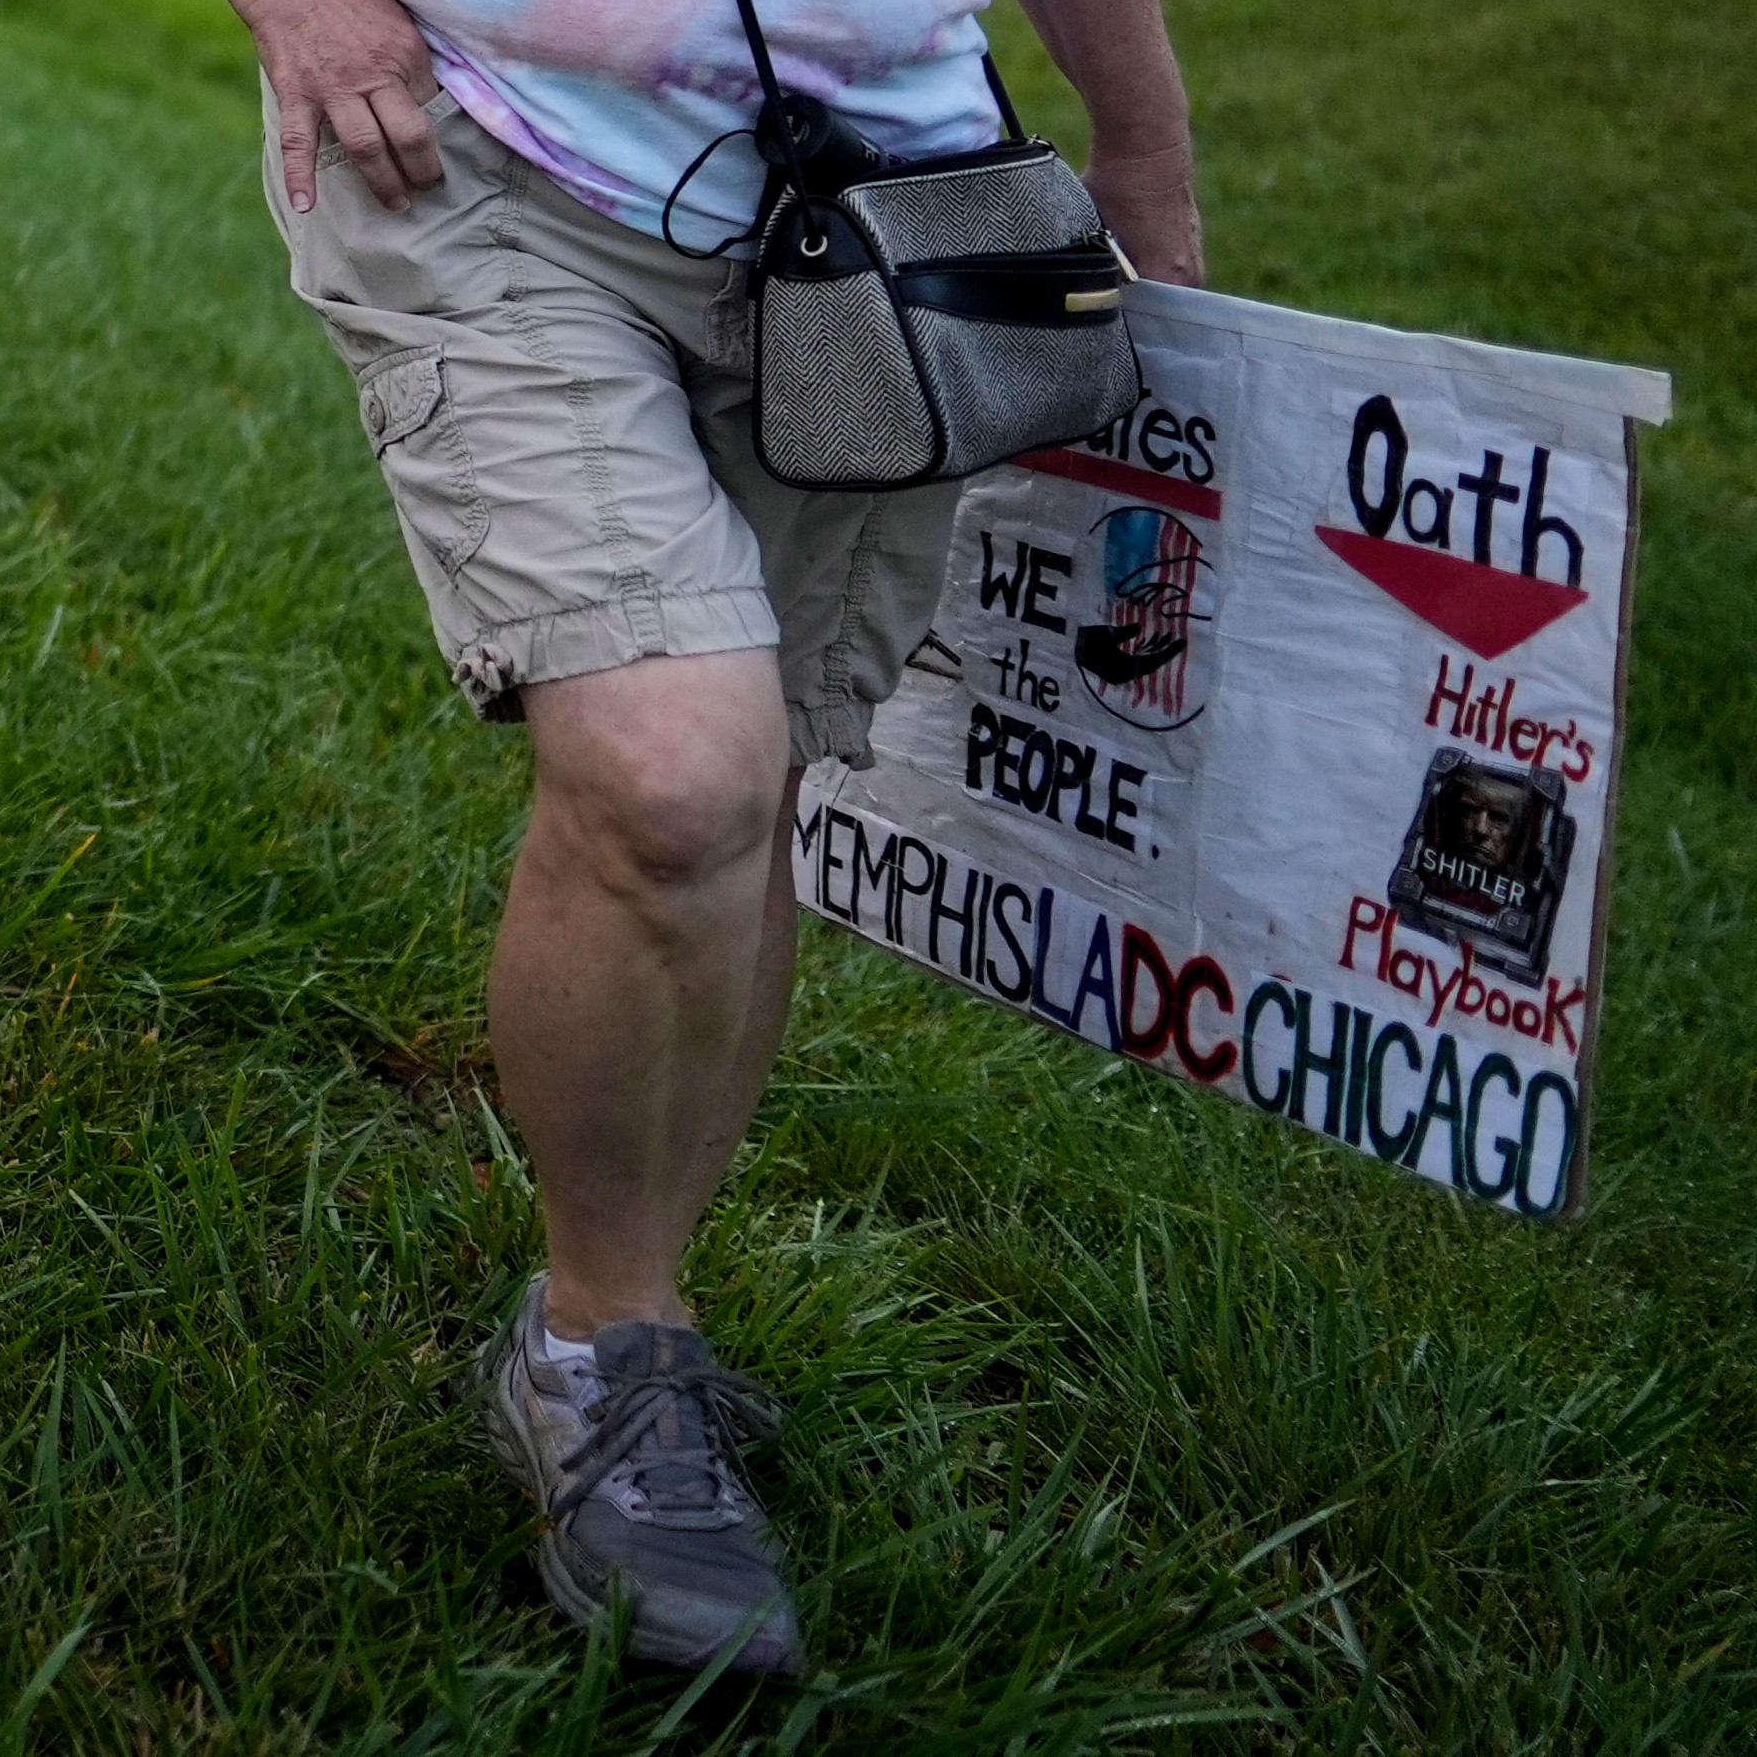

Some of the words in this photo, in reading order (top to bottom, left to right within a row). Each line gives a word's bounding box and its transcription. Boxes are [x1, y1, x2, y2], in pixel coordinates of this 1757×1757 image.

[1347, 394, 1584, 588] Oath
[980, 530, 1074, 636] WE
[991, 640, 1060, 712] the
[1425, 654, 1595, 783] Hitler's
[966, 702, 1161, 860] PEOPLE.
[1422, 846, 1527, 908] SHITLER
[1242, 980, 1577, 1217] CHICAGO
